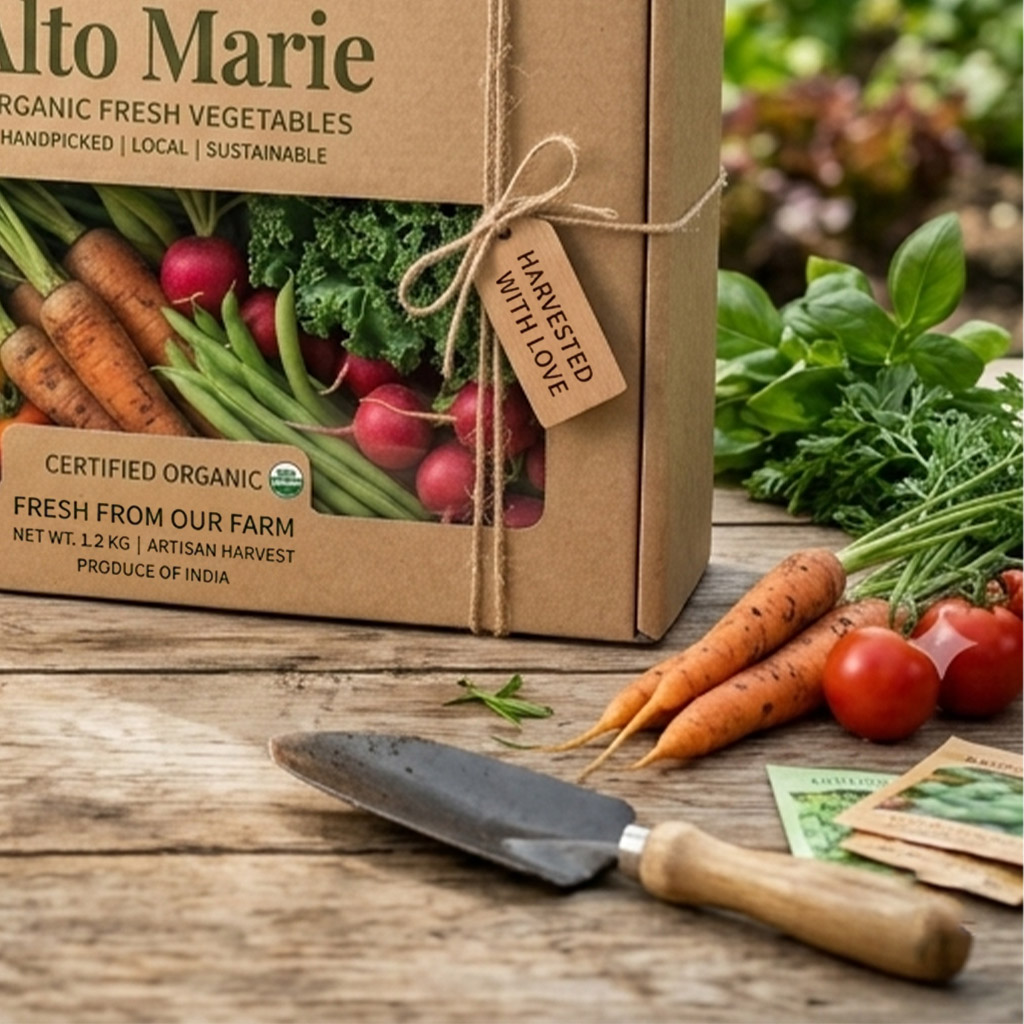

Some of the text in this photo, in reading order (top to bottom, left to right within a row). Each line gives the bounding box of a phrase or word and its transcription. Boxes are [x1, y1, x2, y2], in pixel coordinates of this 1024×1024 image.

[142, 6, 375, 94] Marie
[99, 99, 180, 126] FRESH
[189, 104, 353, 136] VEGETABLES
[0, 128, 114, 152] HANDPICKED
[132, 136, 189, 156] LOCAL
[206, 140, 327, 165] SUSTAINABLE
[496, 270, 569, 397] WITH LOVE
[517, 249, 593, 383] HARVESTED
[45, 453, 263, 491] CERTIFIED ORGANIC
[14, 495, 294, 538] FRESH FROM OUR FARM
[13, 526, 45, 544] NET
[48, 529, 76, 546] WT.
[81, 533, 104, 549] 1.2
[108, 535, 130, 551] KG
[147, 537, 217, 559] ARTISAN
[222, 543, 296, 564] HARVEST
[159, 564, 182, 580] OF
[185, 567, 230, 585] INDIA
